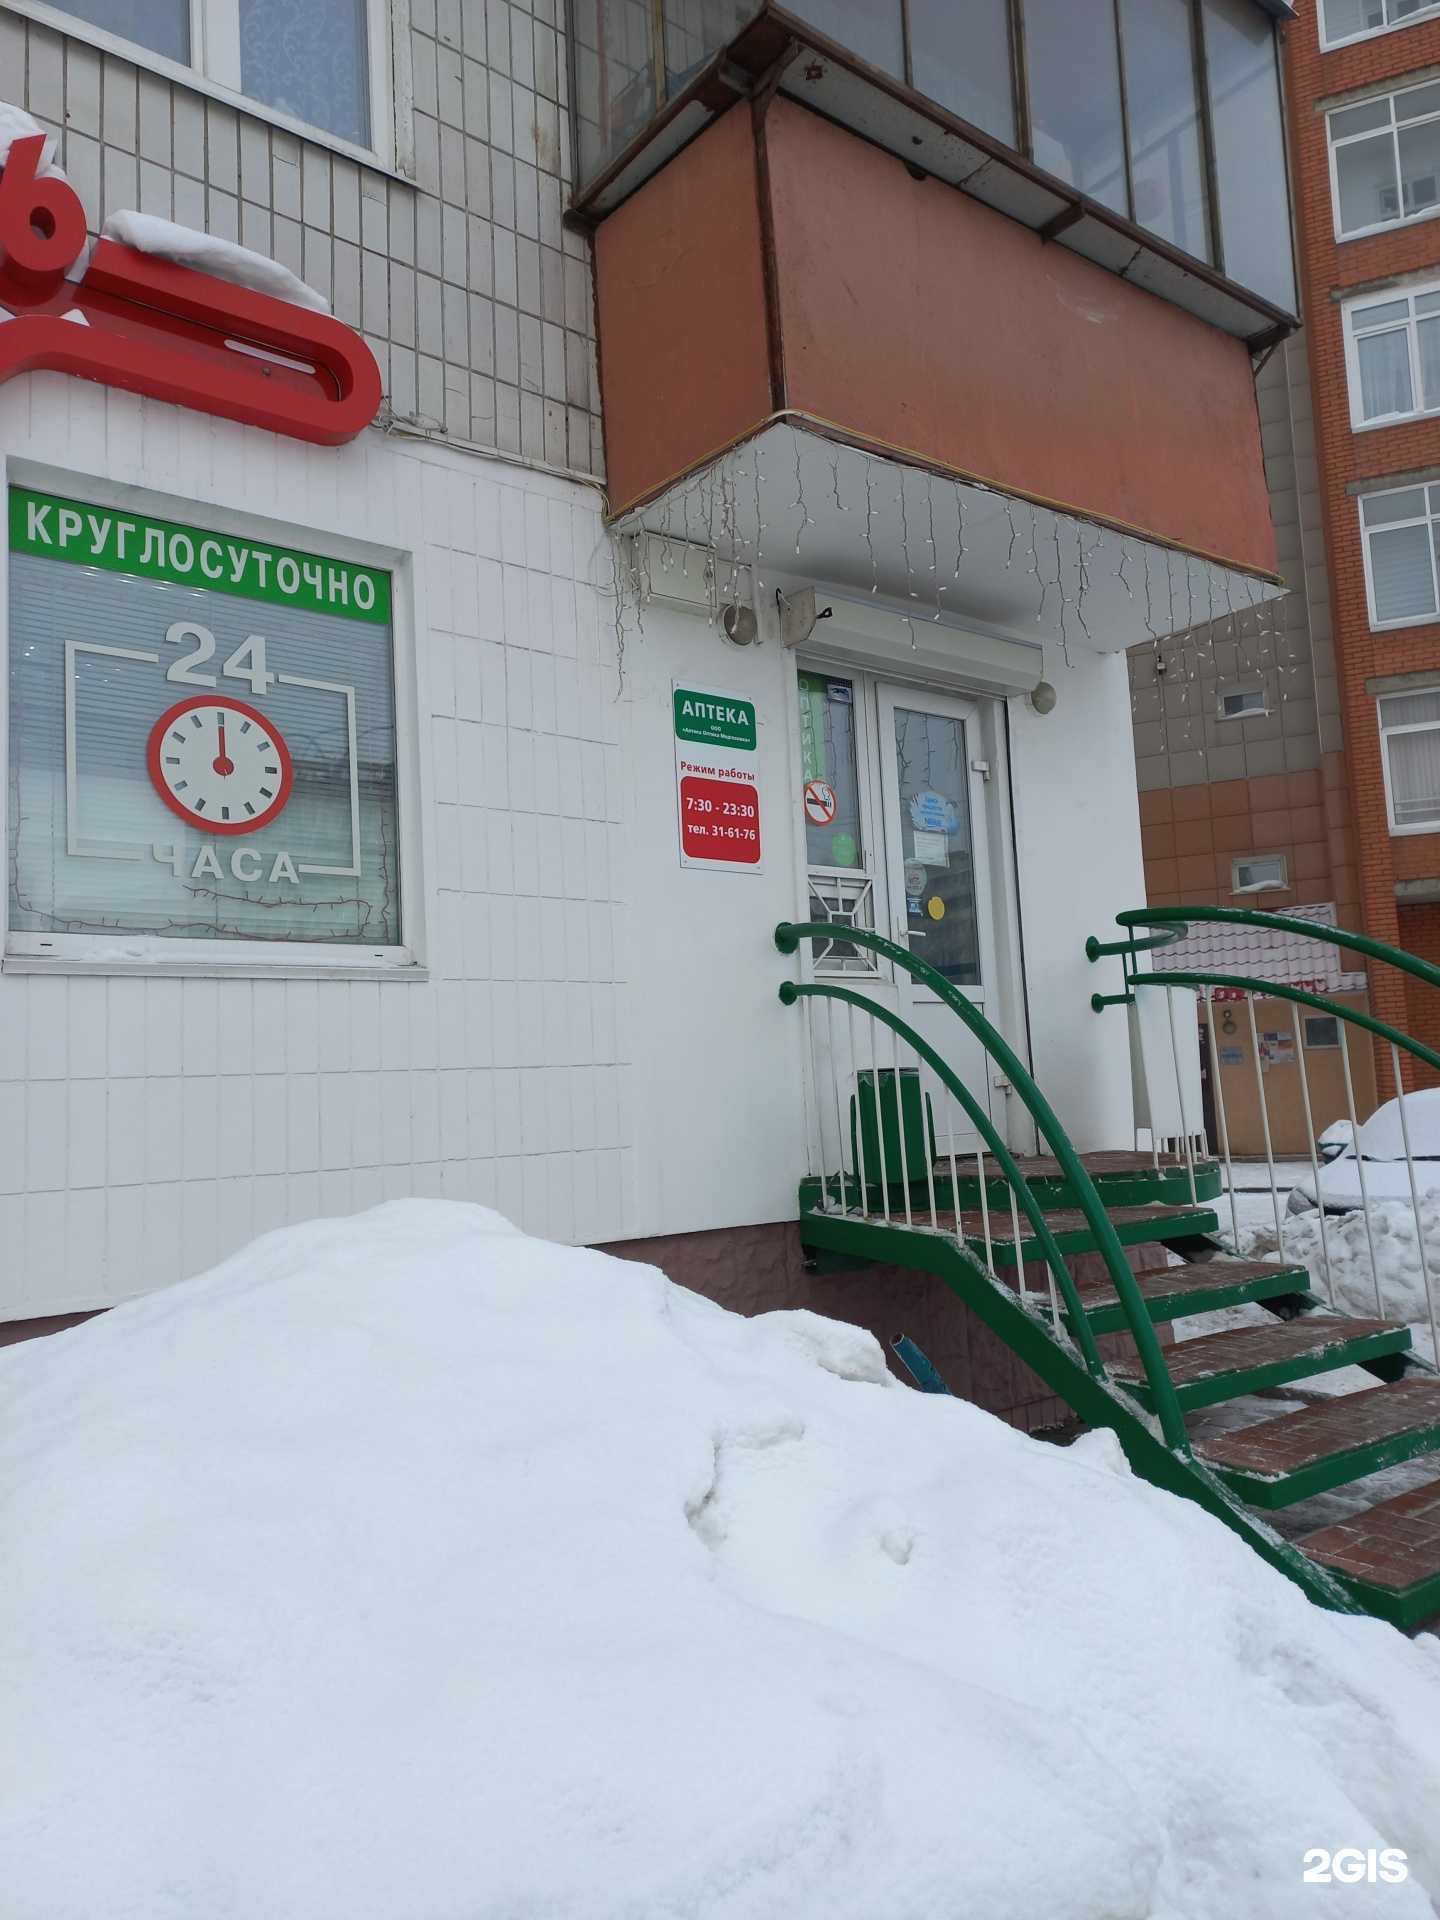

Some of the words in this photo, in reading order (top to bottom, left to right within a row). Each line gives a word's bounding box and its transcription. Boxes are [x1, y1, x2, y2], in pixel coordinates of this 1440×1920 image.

[26, 501, 376, 611] КРУГЛОСУТОЧНО
[164, 621, 275, 695] 24
[682, 700, 749, 726] АПТЕКА
[680, 761, 716, 775] Режим
[718, 768, 755, 781] работы
[685, 797, 712, 813] 7:30
[722, 802, 754, 818] 23:30
[688, 825, 709, 836] тел.
[711, 825, 756, 841] 31-61-76
[151, 842, 300, 884] ЧАСА
